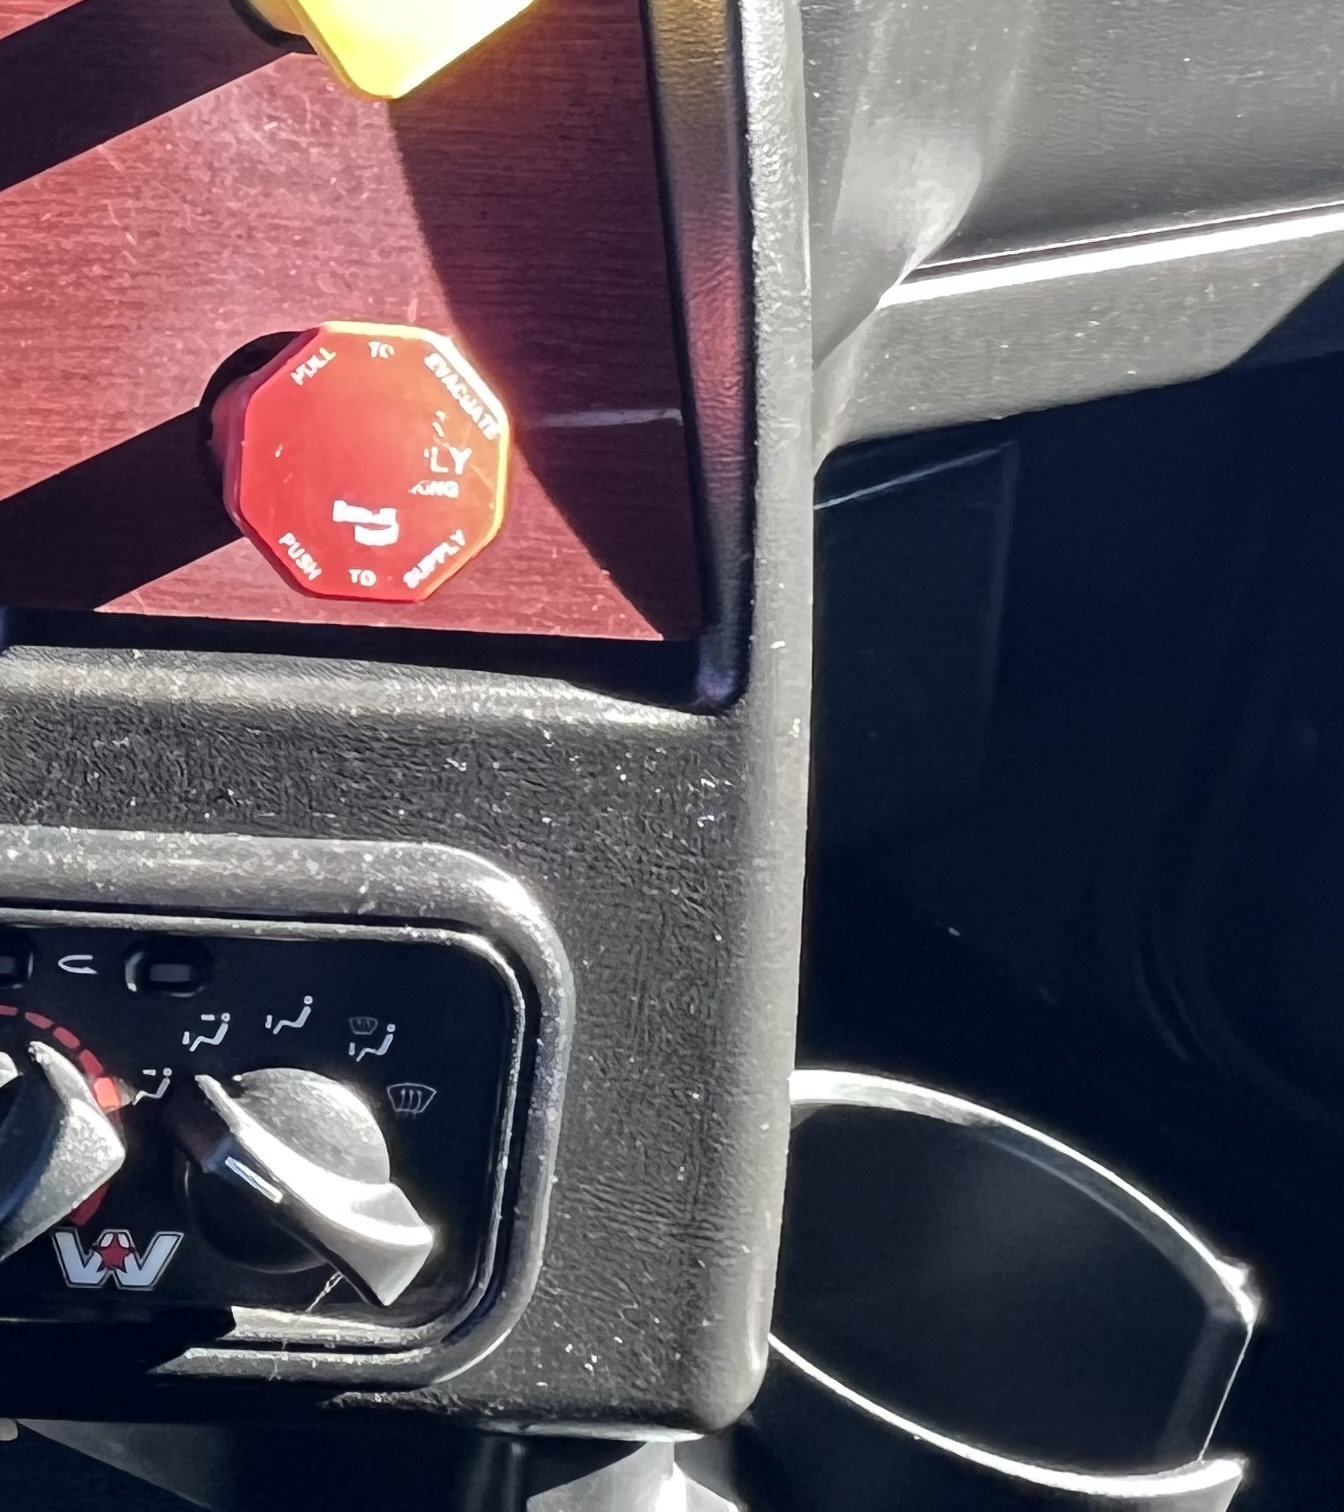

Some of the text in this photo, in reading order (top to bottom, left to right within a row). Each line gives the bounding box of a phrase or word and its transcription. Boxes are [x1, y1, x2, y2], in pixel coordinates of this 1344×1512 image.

[290, 341, 502, 441] PULL TO EVACUATE
[278, 529, 466, 589] PUSH TO SUPPLY
